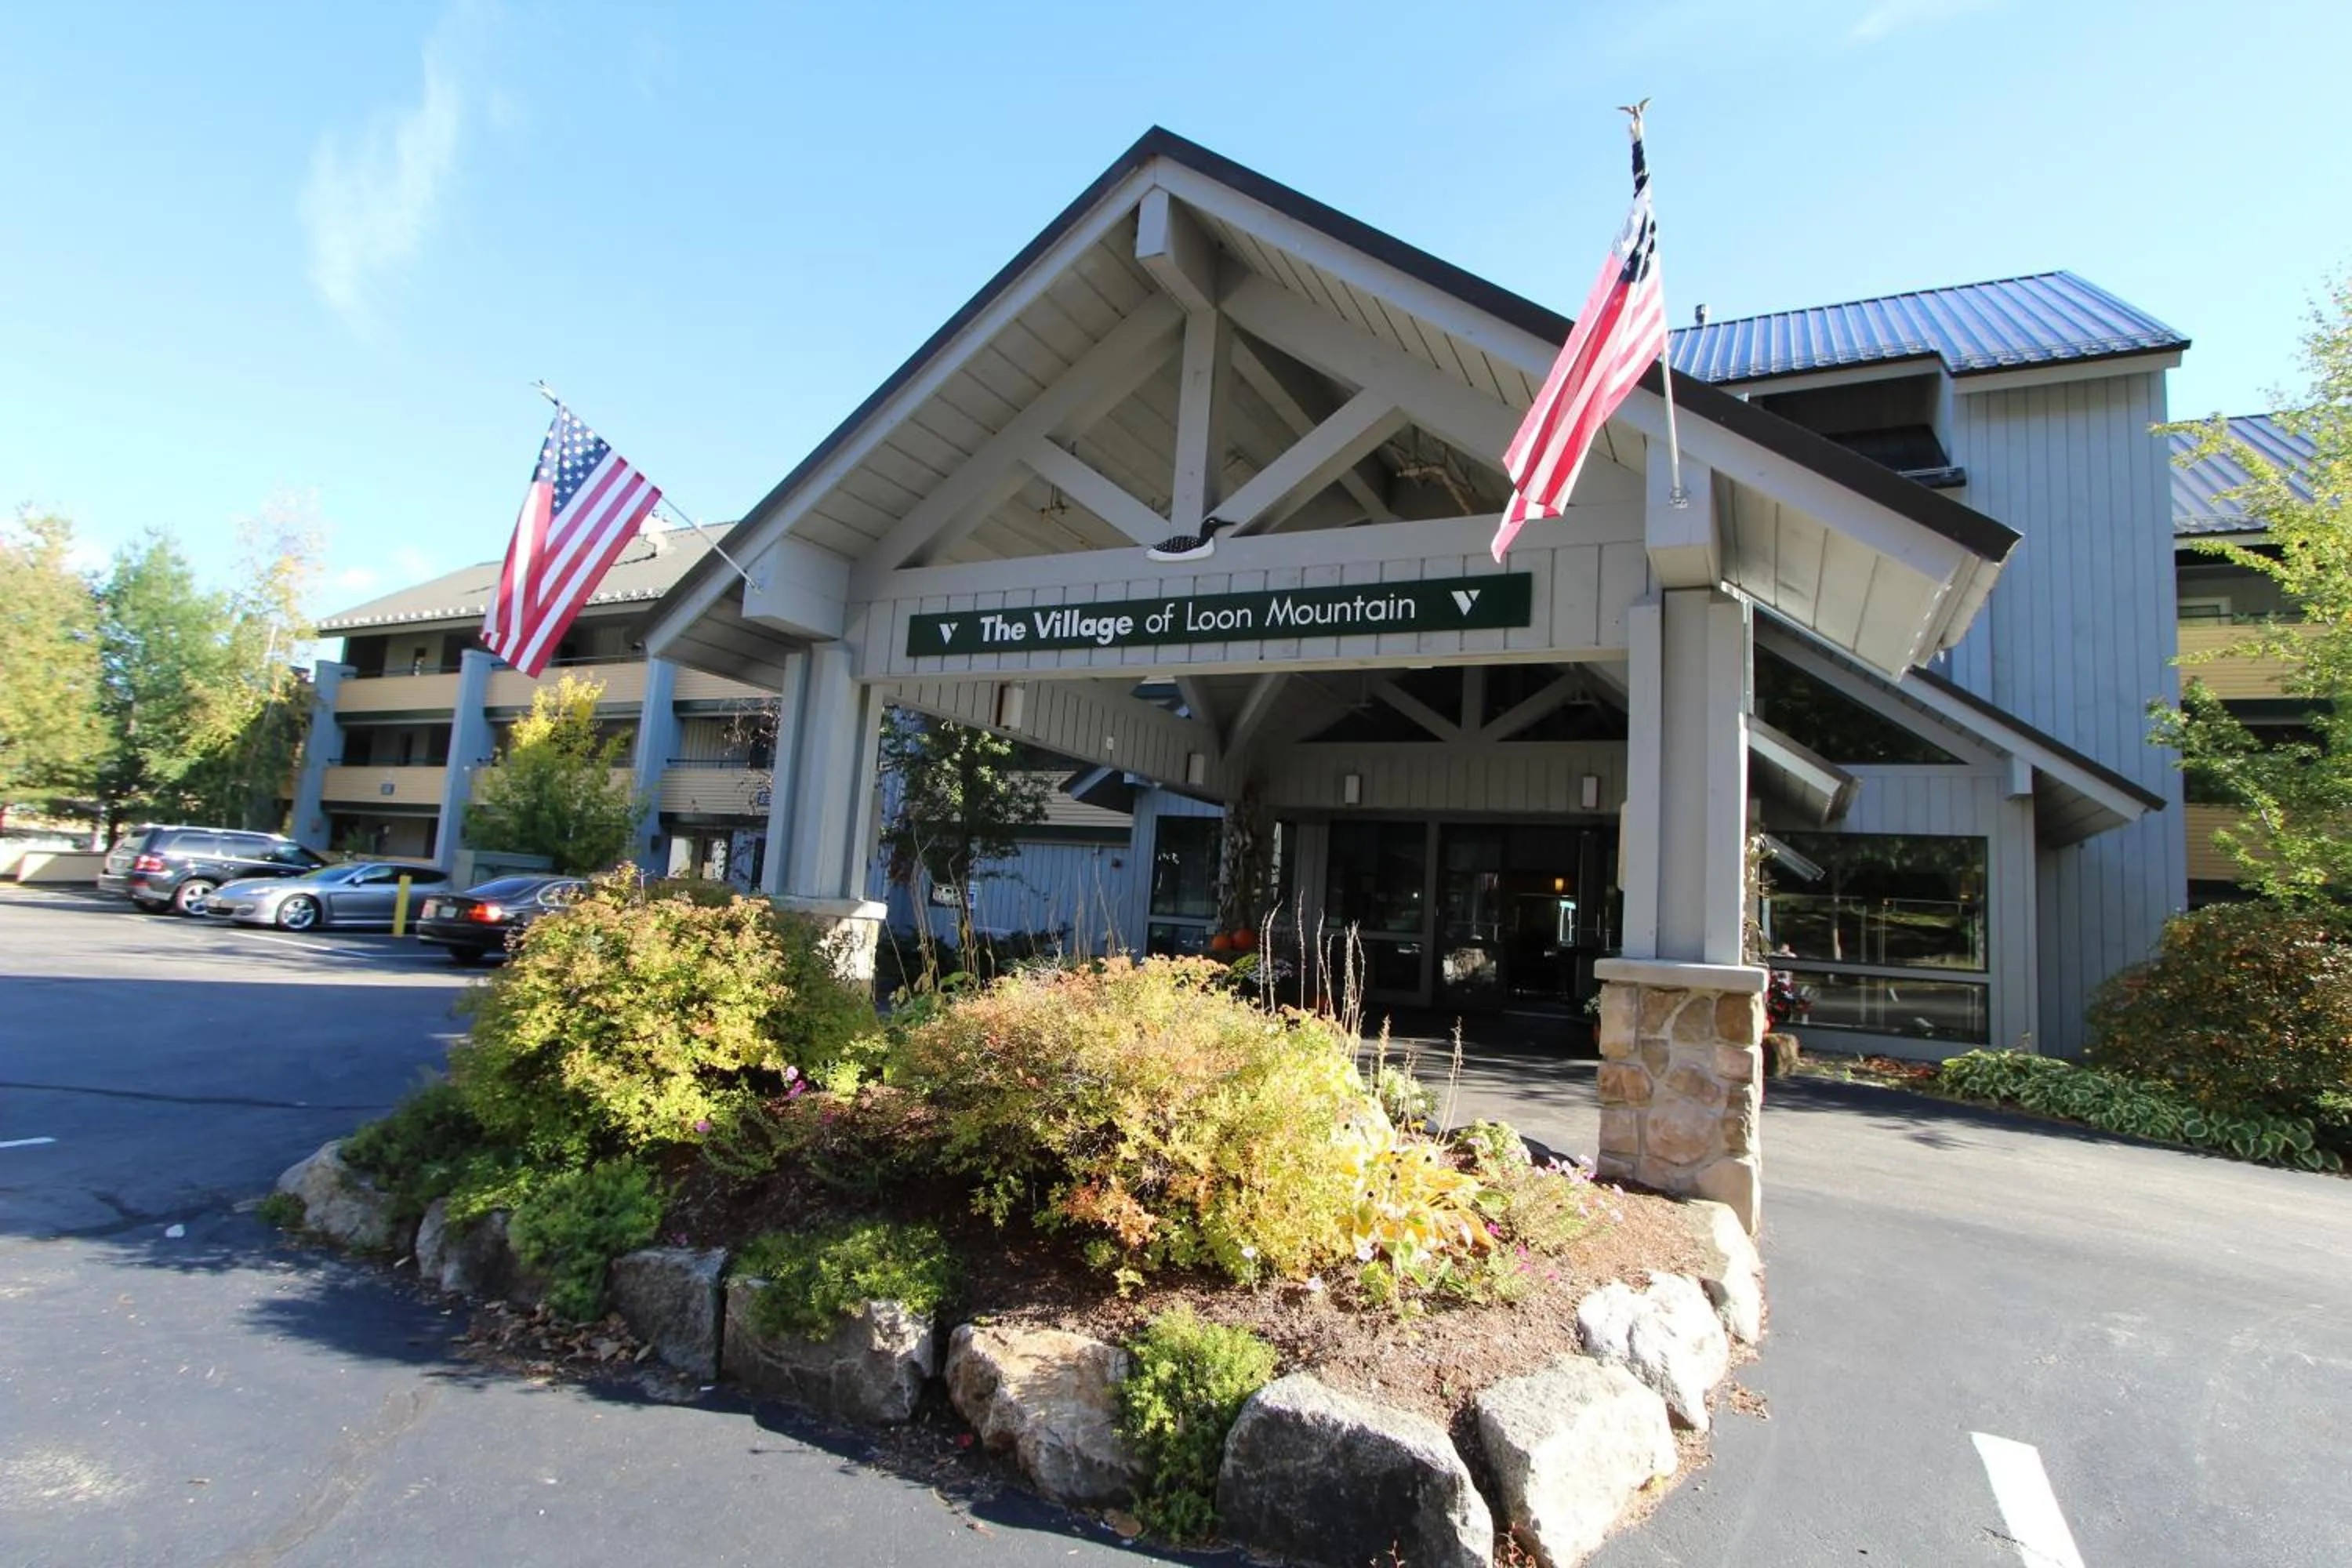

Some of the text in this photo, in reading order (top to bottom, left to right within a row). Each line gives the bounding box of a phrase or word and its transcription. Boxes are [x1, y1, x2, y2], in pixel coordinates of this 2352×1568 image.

[980, 595, 1416, 645] The Village of Loon Mountain
